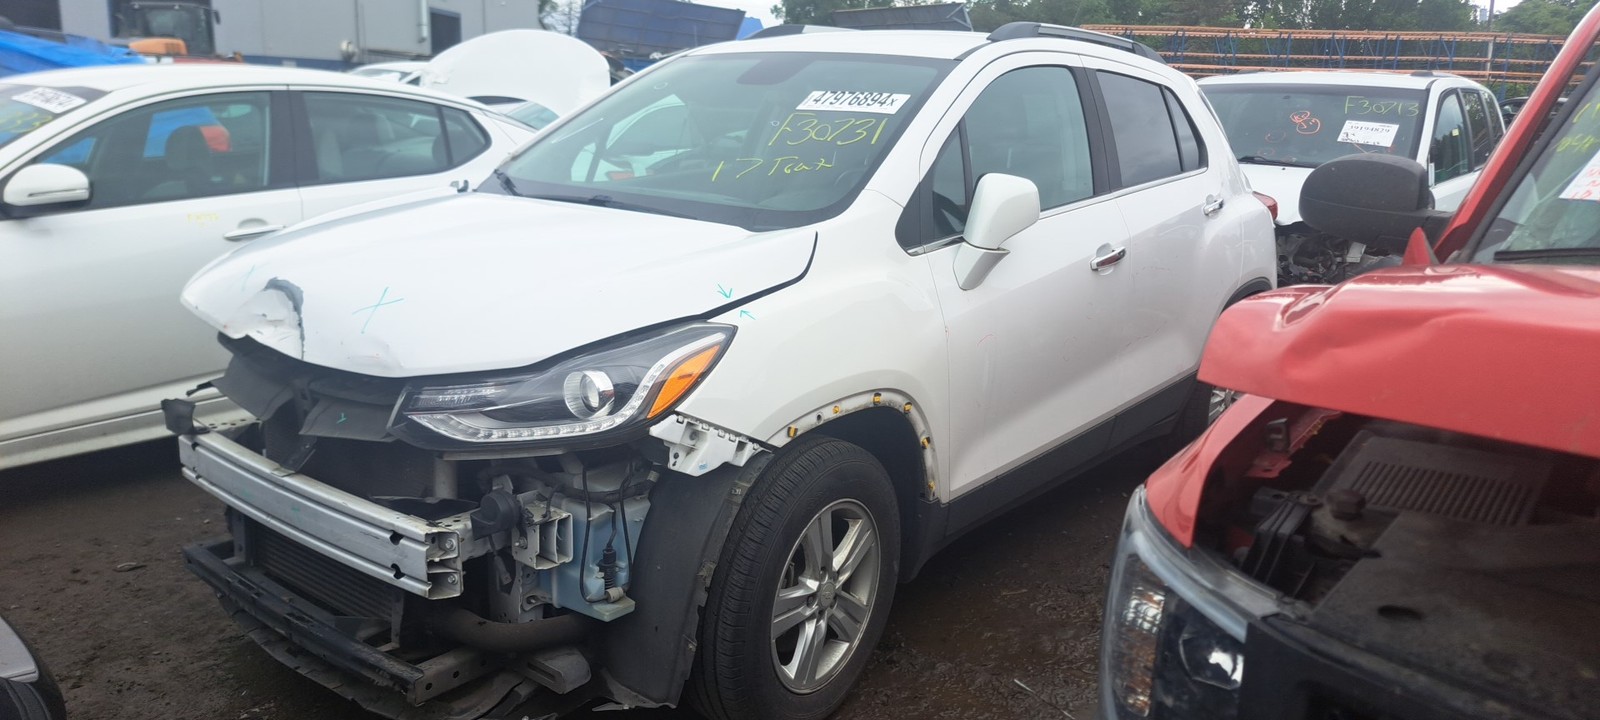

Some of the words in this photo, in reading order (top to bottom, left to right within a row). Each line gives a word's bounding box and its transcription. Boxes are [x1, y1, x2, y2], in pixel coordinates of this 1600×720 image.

[1344, 96, 1420, 116] F30713
[768, 113, 888, 145] F30731
[712, 158, 763, 182] 17
